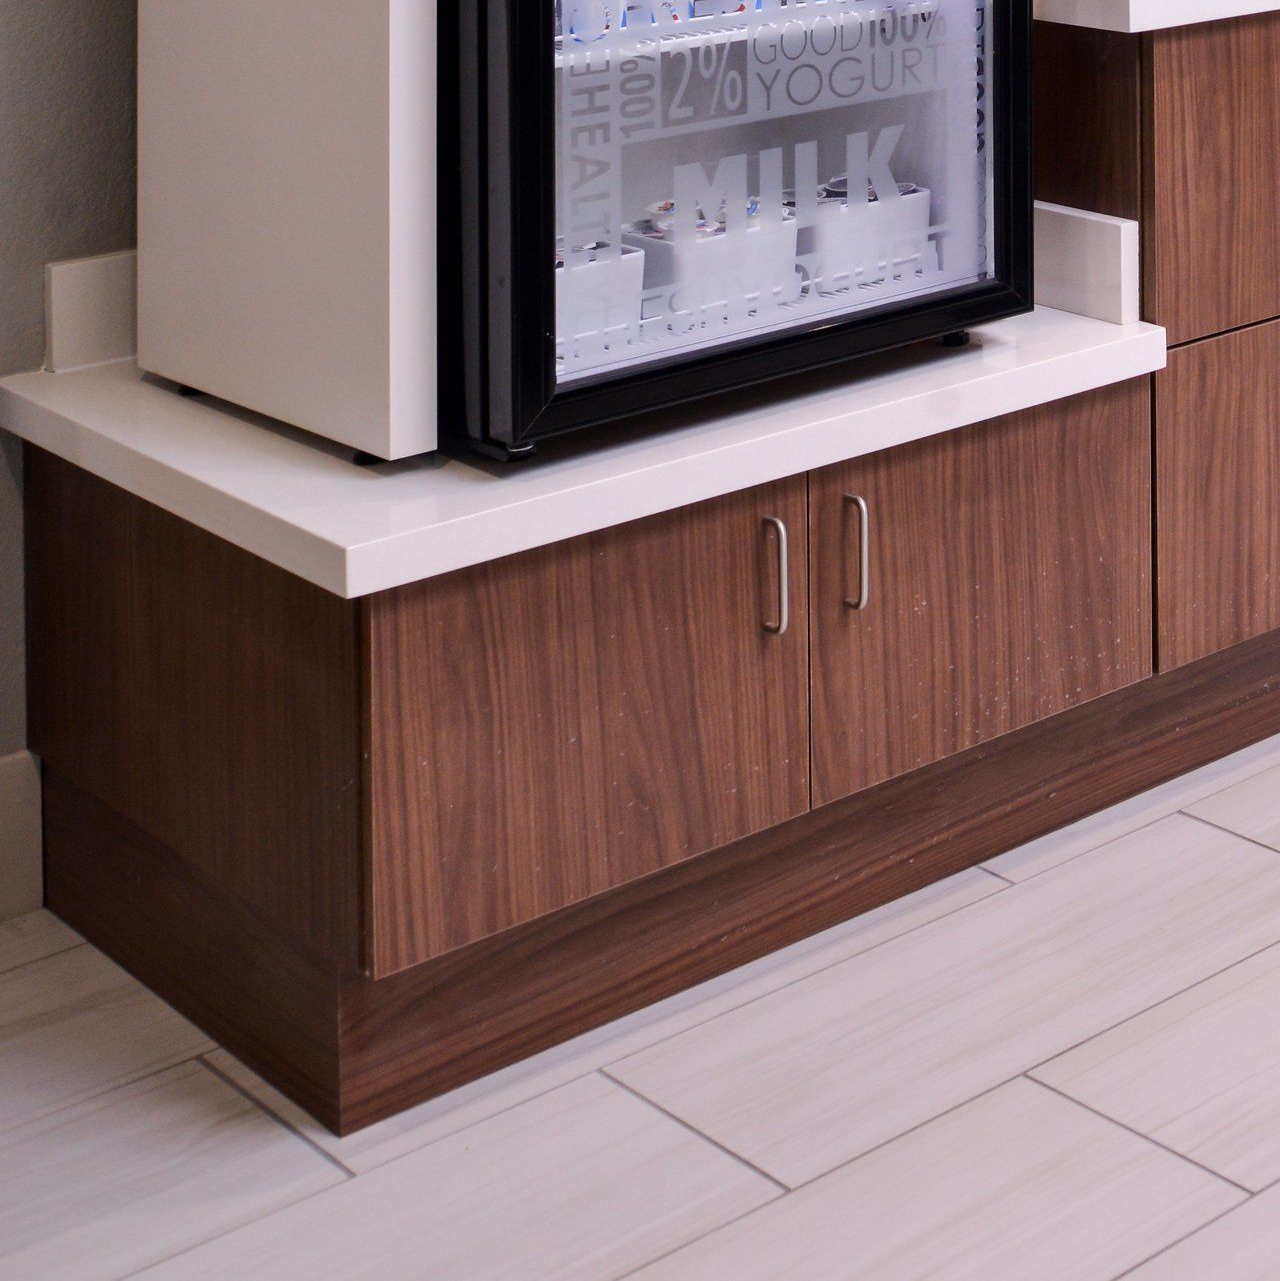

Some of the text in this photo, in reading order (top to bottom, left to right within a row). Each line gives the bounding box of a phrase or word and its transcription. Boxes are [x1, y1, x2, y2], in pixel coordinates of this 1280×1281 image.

[753, 5, 948, 65] GOOD 100%
[667, 39, 742, 120] 2%
[756, 43, 946, 112] YOGURT
[673, 123, 906, 247] MILK
